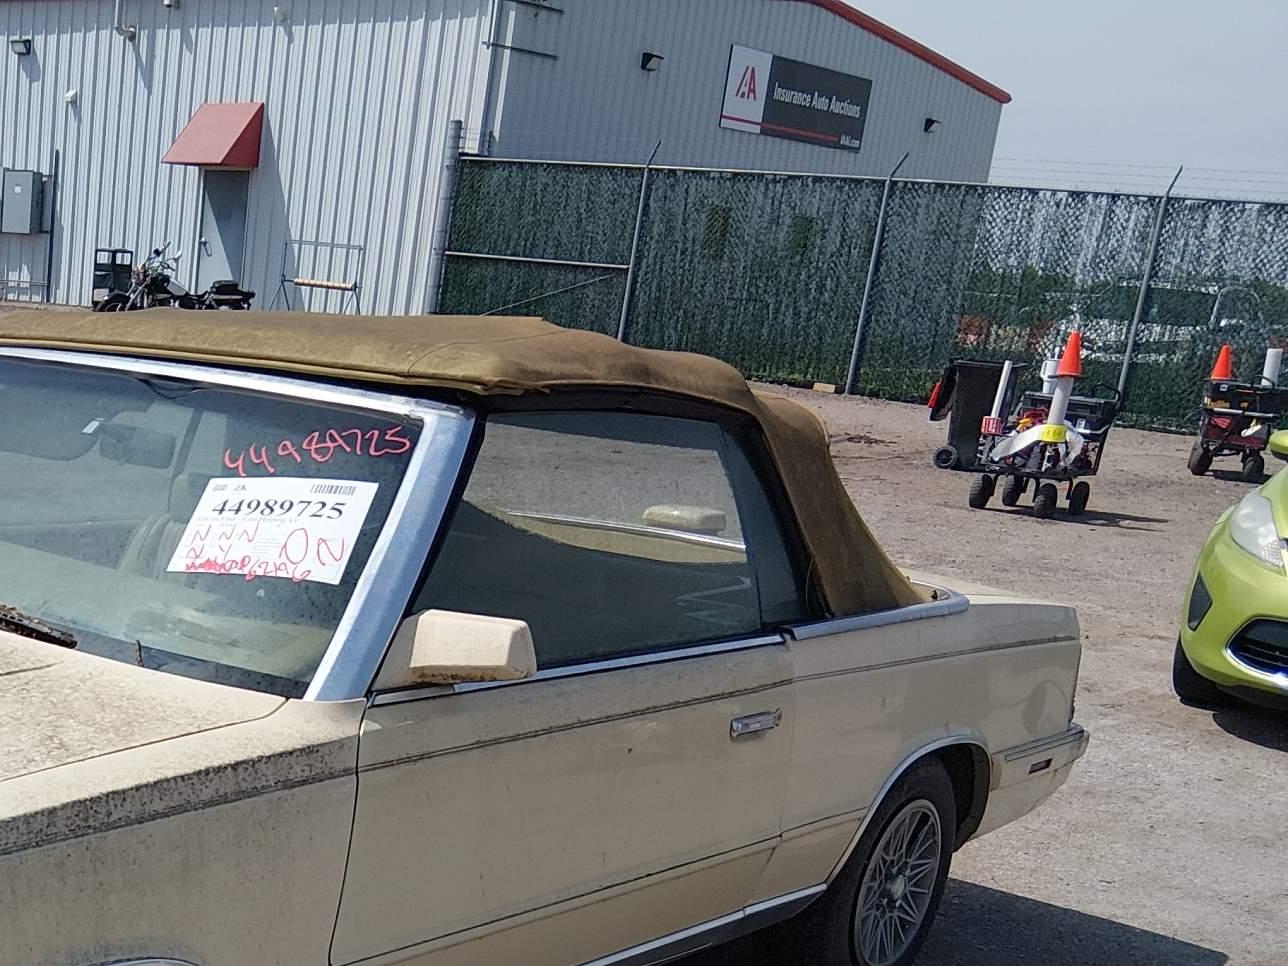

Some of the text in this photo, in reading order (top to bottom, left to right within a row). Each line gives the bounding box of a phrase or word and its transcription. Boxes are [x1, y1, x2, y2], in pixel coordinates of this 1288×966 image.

[773, 82, 861, 118] Insurance Auto Auctions
[223, 426, 411, 477] 44989725
[212, 499, 345, 519] 44989725
